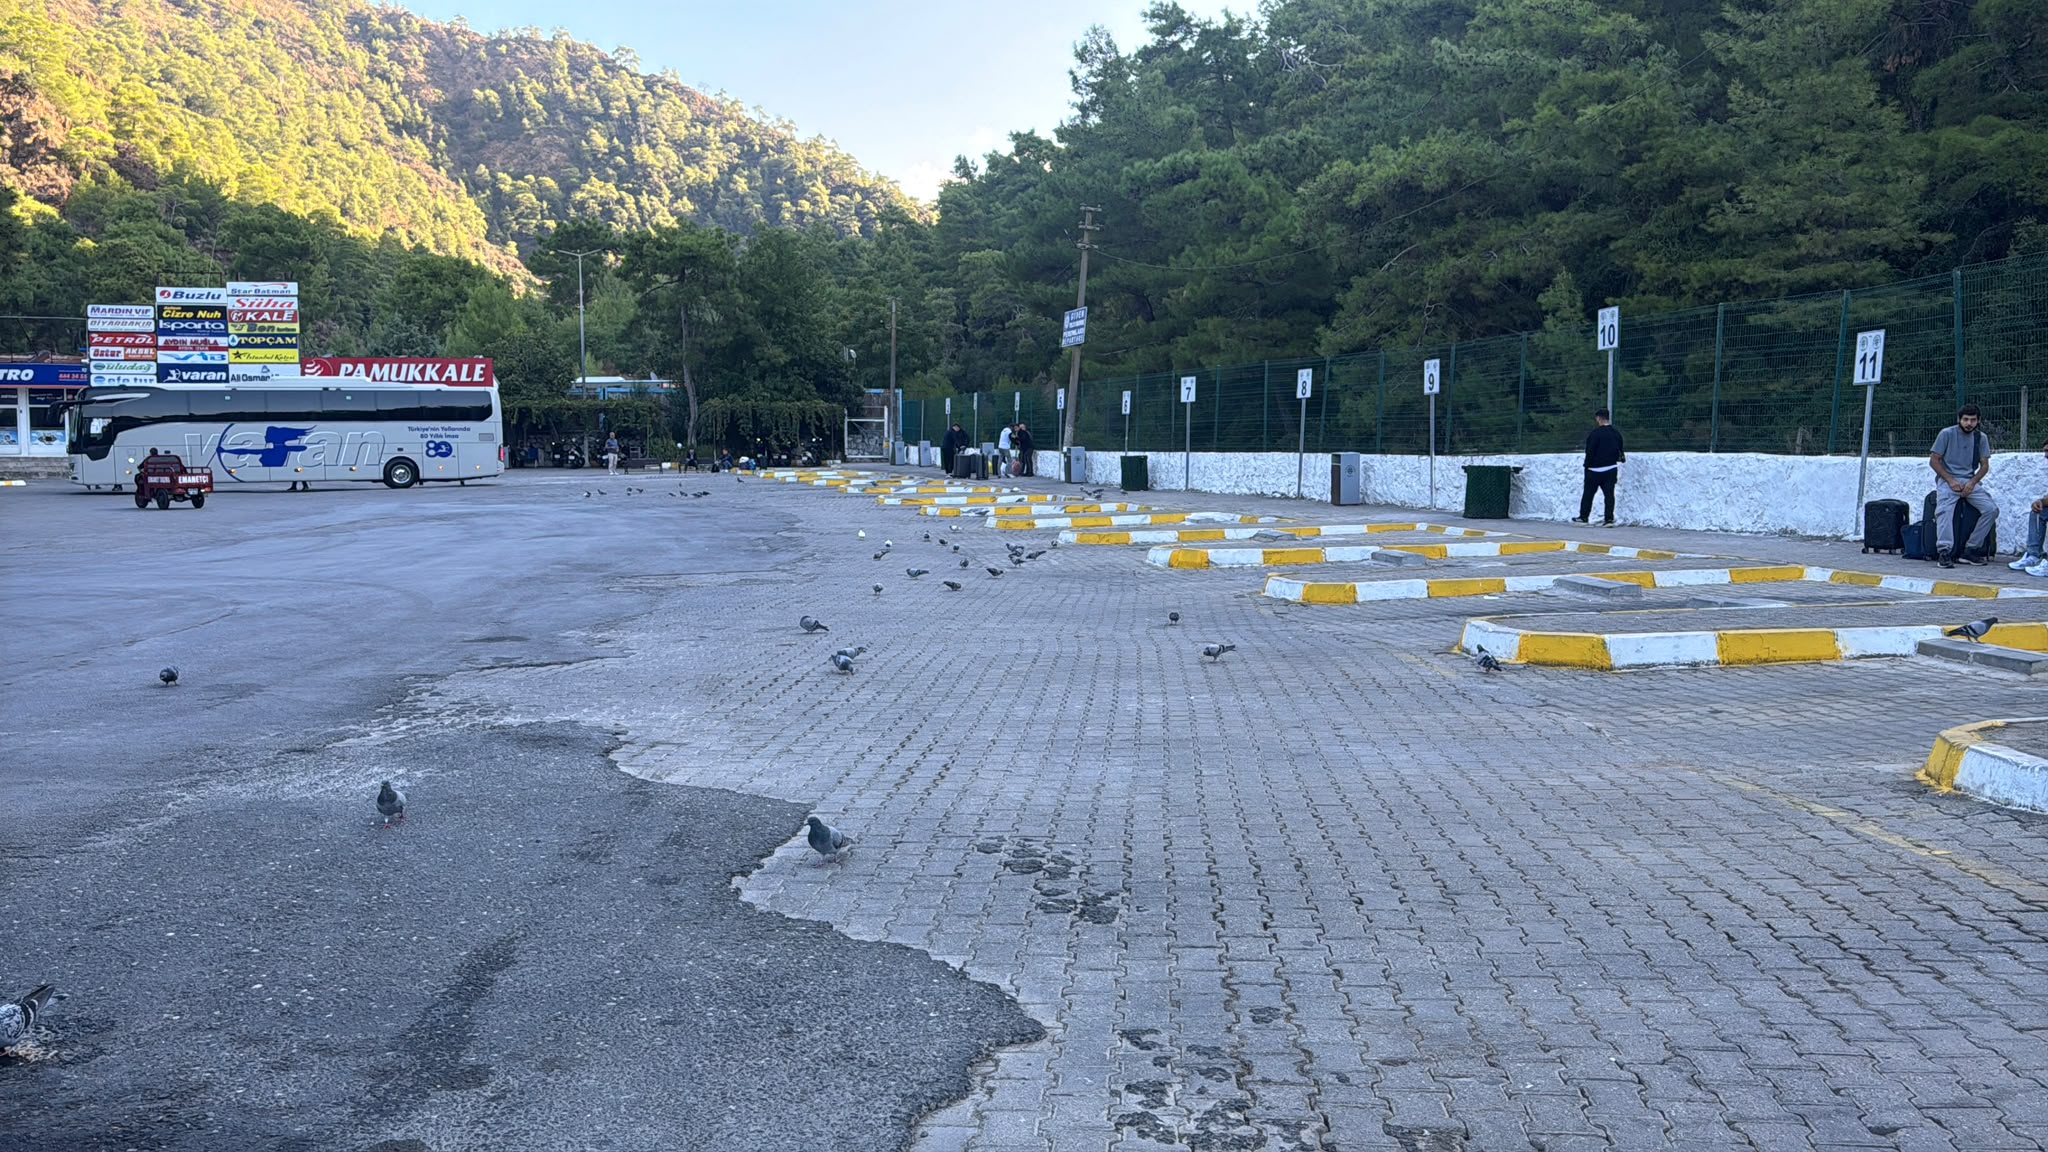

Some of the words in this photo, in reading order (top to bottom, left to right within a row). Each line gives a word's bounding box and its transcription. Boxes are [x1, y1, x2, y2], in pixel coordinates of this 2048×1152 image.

[172, 291, 221, 300] Buzlu
[235, 298, 295, 308] Süha
[197, 310, 221, 318] Nuh
[245, 311, 295, 321] KALE
[92, 336, 154, 344] PETROL
[1600, 323, 1616, 347] 10
[238, 336, 297, 345] TOPÇAM
[1859, 351, 1877, 380] 11
[182, 371, 227, 381] varan
[339, 363, 487, 382] PAMUKKALE
[1428, 373, 1435, 391] 9
[1301, 380, 1307, 396] 8
[1185, 386, 1192, 401] 7
